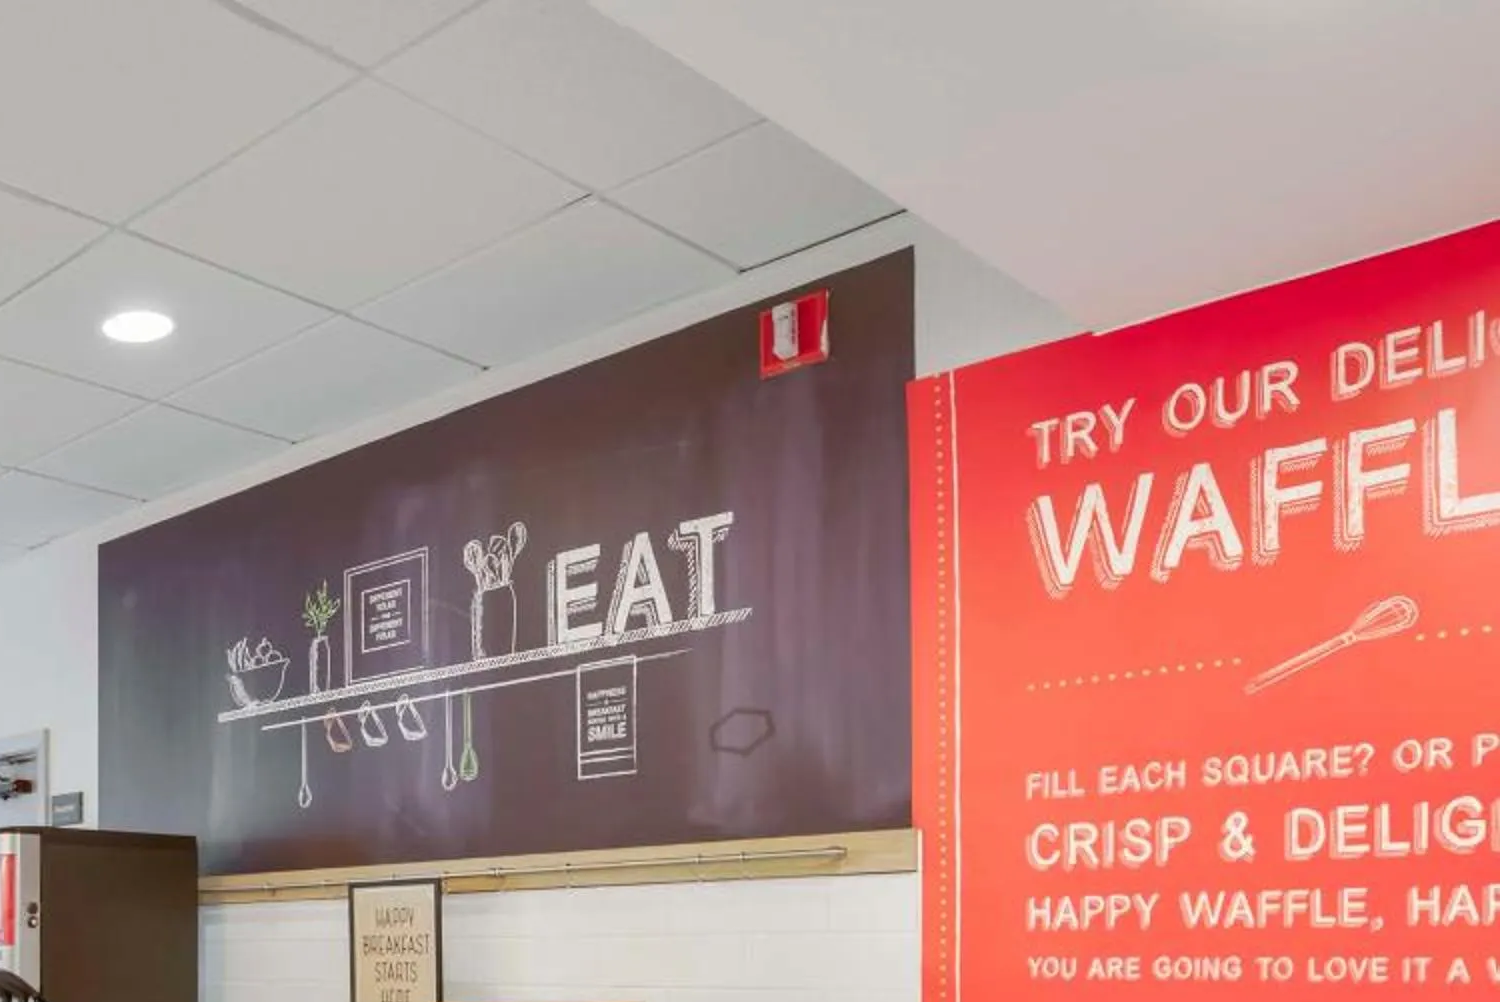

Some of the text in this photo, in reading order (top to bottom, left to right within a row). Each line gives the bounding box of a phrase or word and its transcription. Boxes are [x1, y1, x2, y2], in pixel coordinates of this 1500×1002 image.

[1026, 398, 1136, 468] TRY
[1161, 361, 1300, 437] OUR
[1026, 407, 1500, 601] WAFFL
[547, 511, 734, 646] EAT
[587, 721, 627, 742] SMILE
[1026, 769, 1085, 801] FILL
[1098, 760, 1187, 795] EACH
[1201, 743, 1376, 788] SQUARE?
[1392, 737, 1454, 773] OR
[1026, 816, 1192, 870] CRISP
[1221, 811, 1257, 862] &
[1026, 892, 1160, 932] HAPPY
[1179, 887, 1385, 934] WAFFLE,
[362, 933, 431, 957] BREAKFAST
[374, 960, 418, 983] STARTS
[1027, 956, 1078, 981] YOU
[1087, 956, 1141, 982] ARE
[1152, 955, 1243, 982] GOING
[1257, 956, 1294, 982] TO
[1306, 956, 1389, 984] LOVE
[1401, 956, 1433, 984] IT
[1446, 956, 1472, 985] A
